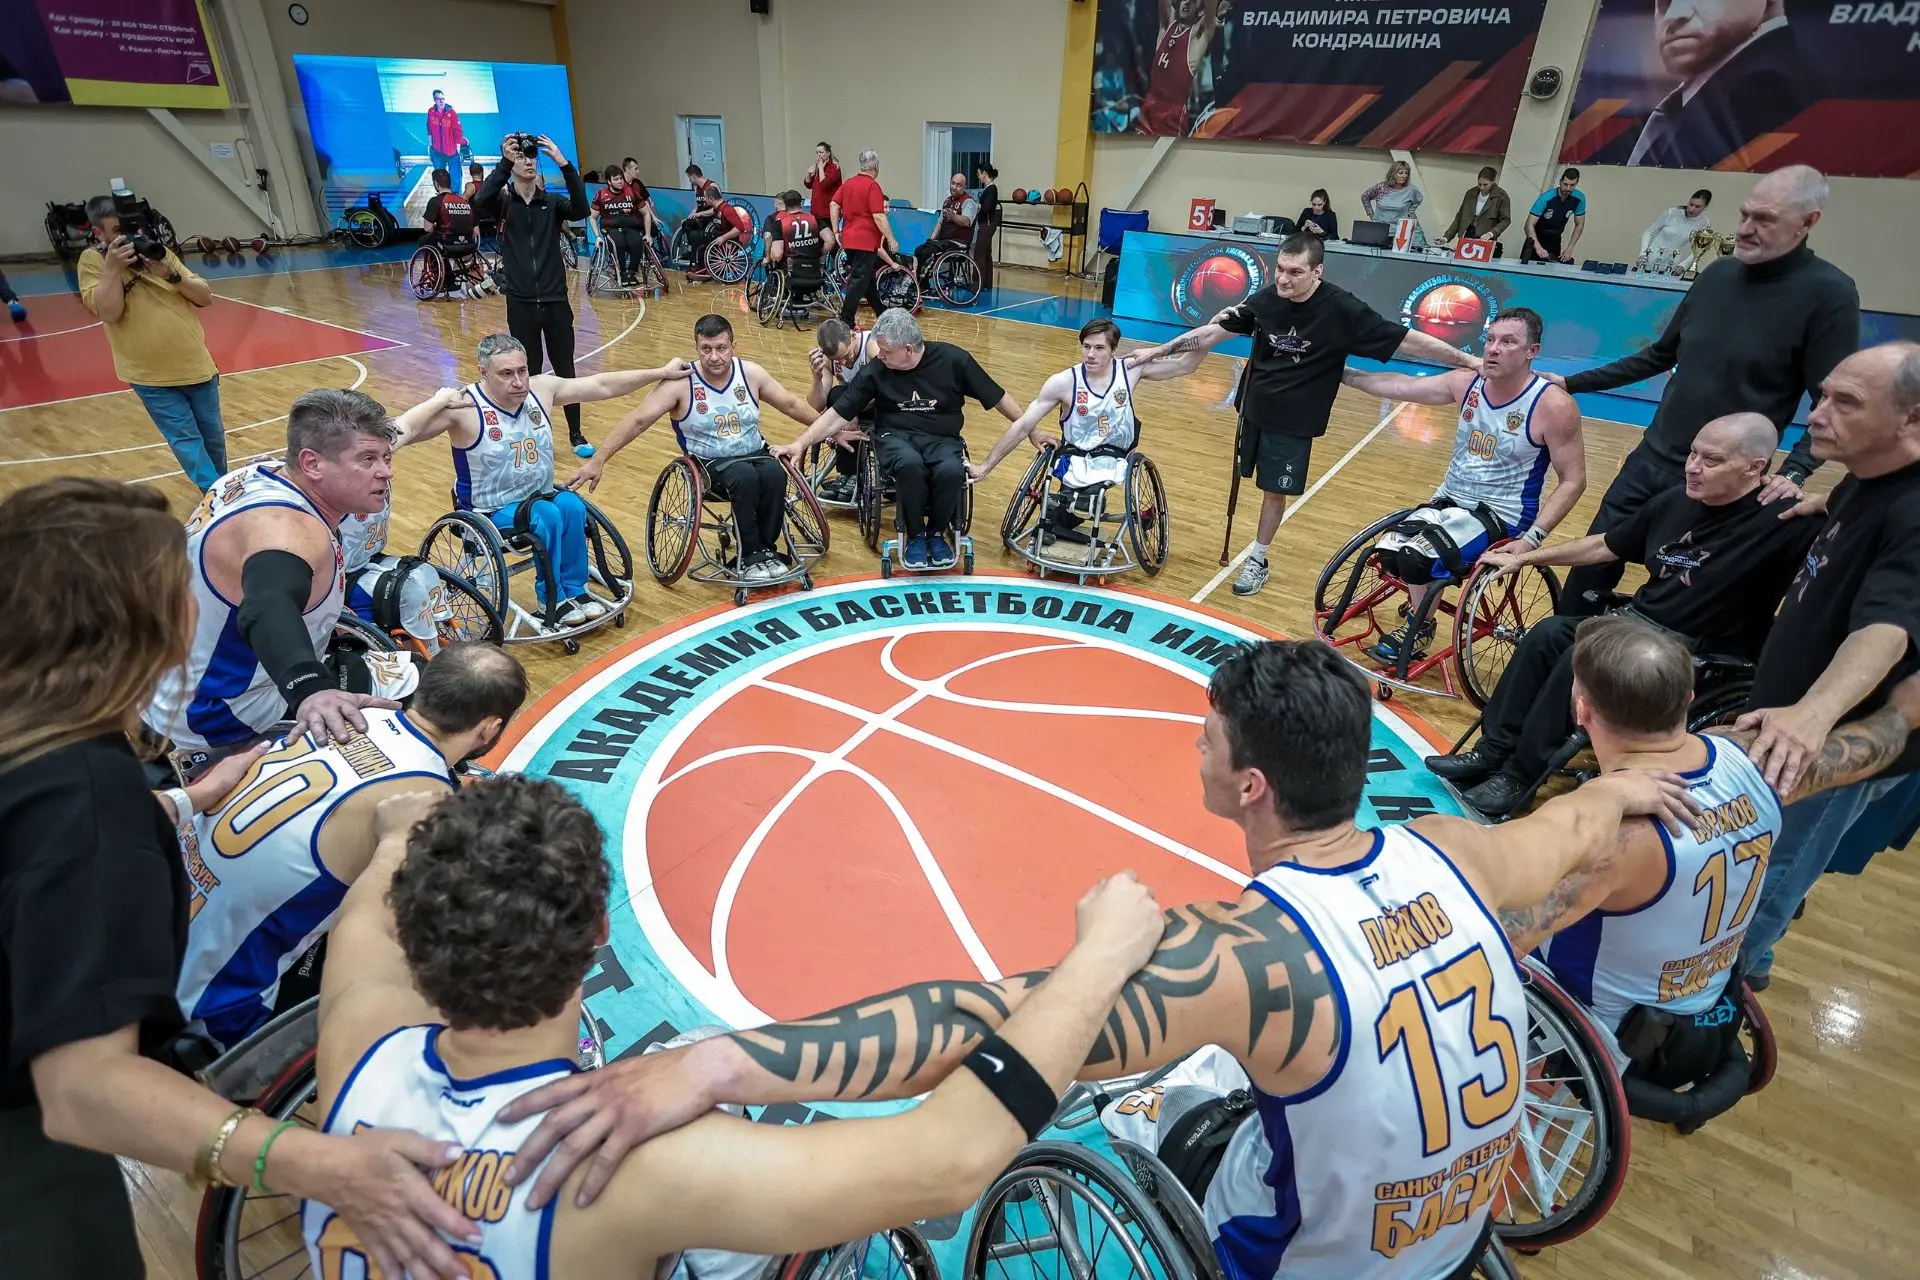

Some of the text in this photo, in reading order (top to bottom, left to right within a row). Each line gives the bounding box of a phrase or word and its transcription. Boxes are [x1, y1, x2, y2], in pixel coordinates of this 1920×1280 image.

[1242, 7, 1511, 28] ВЛАДИМИРА ПЕТРОВИЧА
[1292, 33, 1441, 50] КОНДРАШИНА
[1157, 53, 1170, 69] 14
[444, 202, 471, 210] FALCON
[1192, 205, 1206, 227] 5
[791, 220, 812, 239] 22
[788, 237, 819, 249] MOSCOW
[1461, 242, 1485, 259] 5
[714, 412, 741, 437] 26
[1097, 415, 1110, 437] 5
[509, 438, 539, 468] 78
[1468, 430, 1497, 460] 00
[365, 522, 387, 550] 24
[548, 616, 802, 784] АКАДЕМИЯ
[797, 590, 1135, 635] БАСКЕТБОЛА
[193, 753, 207, 763] 23
[1692, 830, 1773, 946] 17
[1374, 942, 1520, 1159] 13
